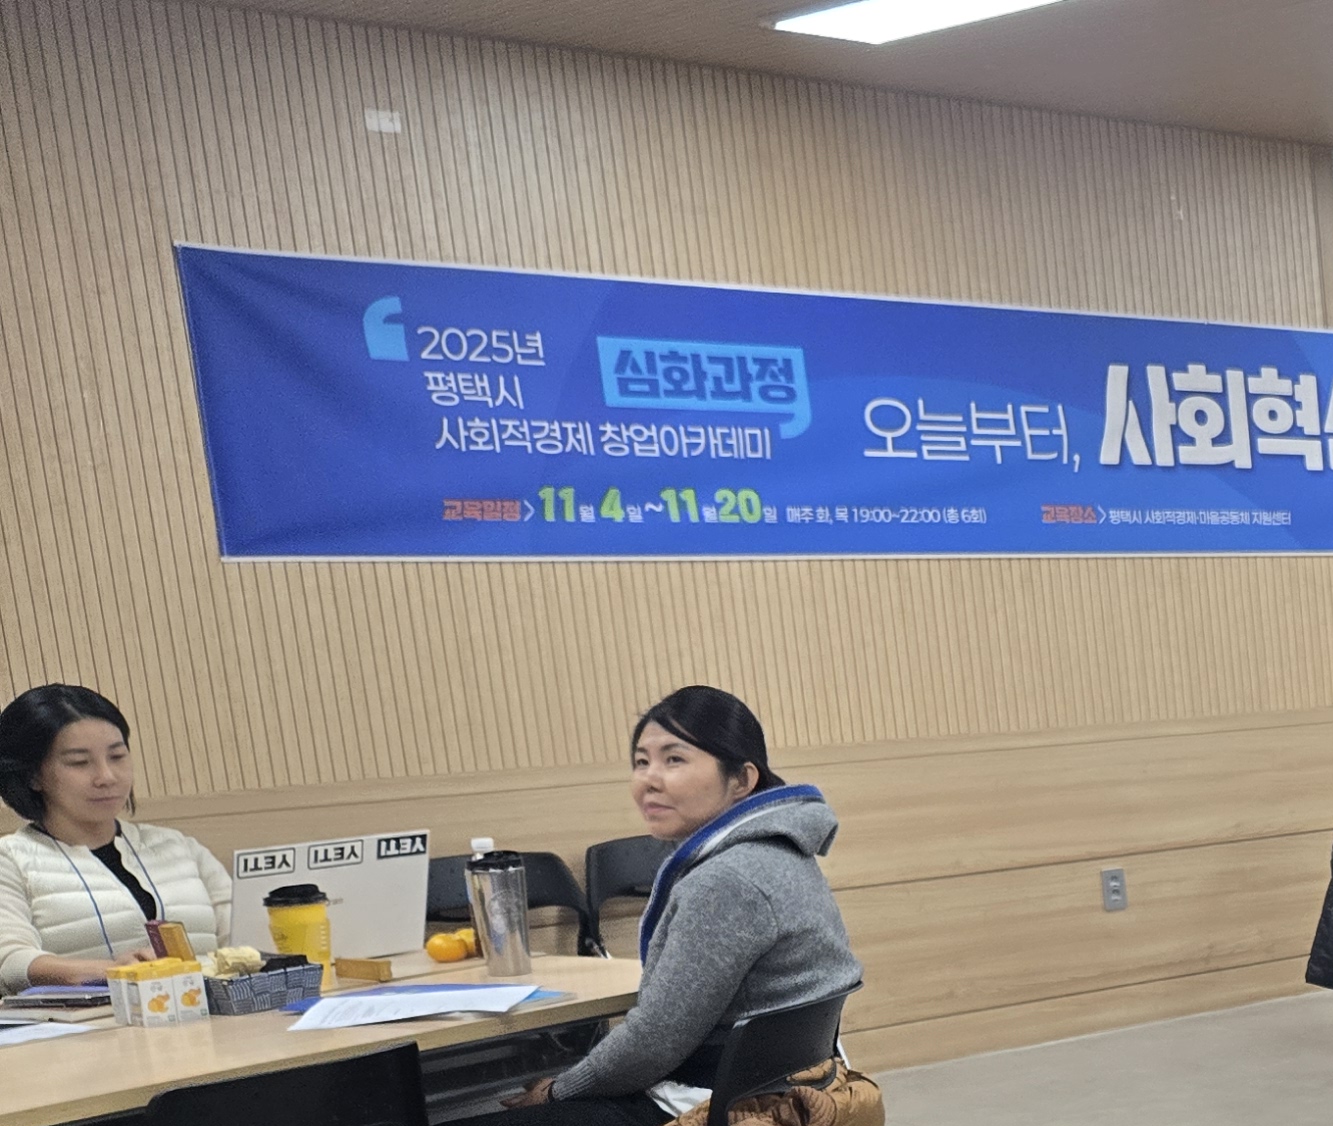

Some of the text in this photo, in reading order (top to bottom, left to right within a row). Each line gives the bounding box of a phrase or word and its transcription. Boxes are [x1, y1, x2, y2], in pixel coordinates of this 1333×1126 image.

[416, 326, 546, 366] 2025년
[424, 370, 524, 409] 평택시
[613, 349, 799, 405] 심화과정
[435, 416, 772, 460] 사회적경제 창업아카데미
[863, 397, 1081, 473] 오늘부터,
[786, 505, 814, 524] 매주
[852, 507, 941, 524] 19:00~22:00
[1109, 509, 1142, 525] 평택시
[1252, 510, 1292, 526] 지원센터
[313, 845, 359, 864] YETI
[380, 836, 425, 857] YETI
[243, 853, 291, 873] YETI
